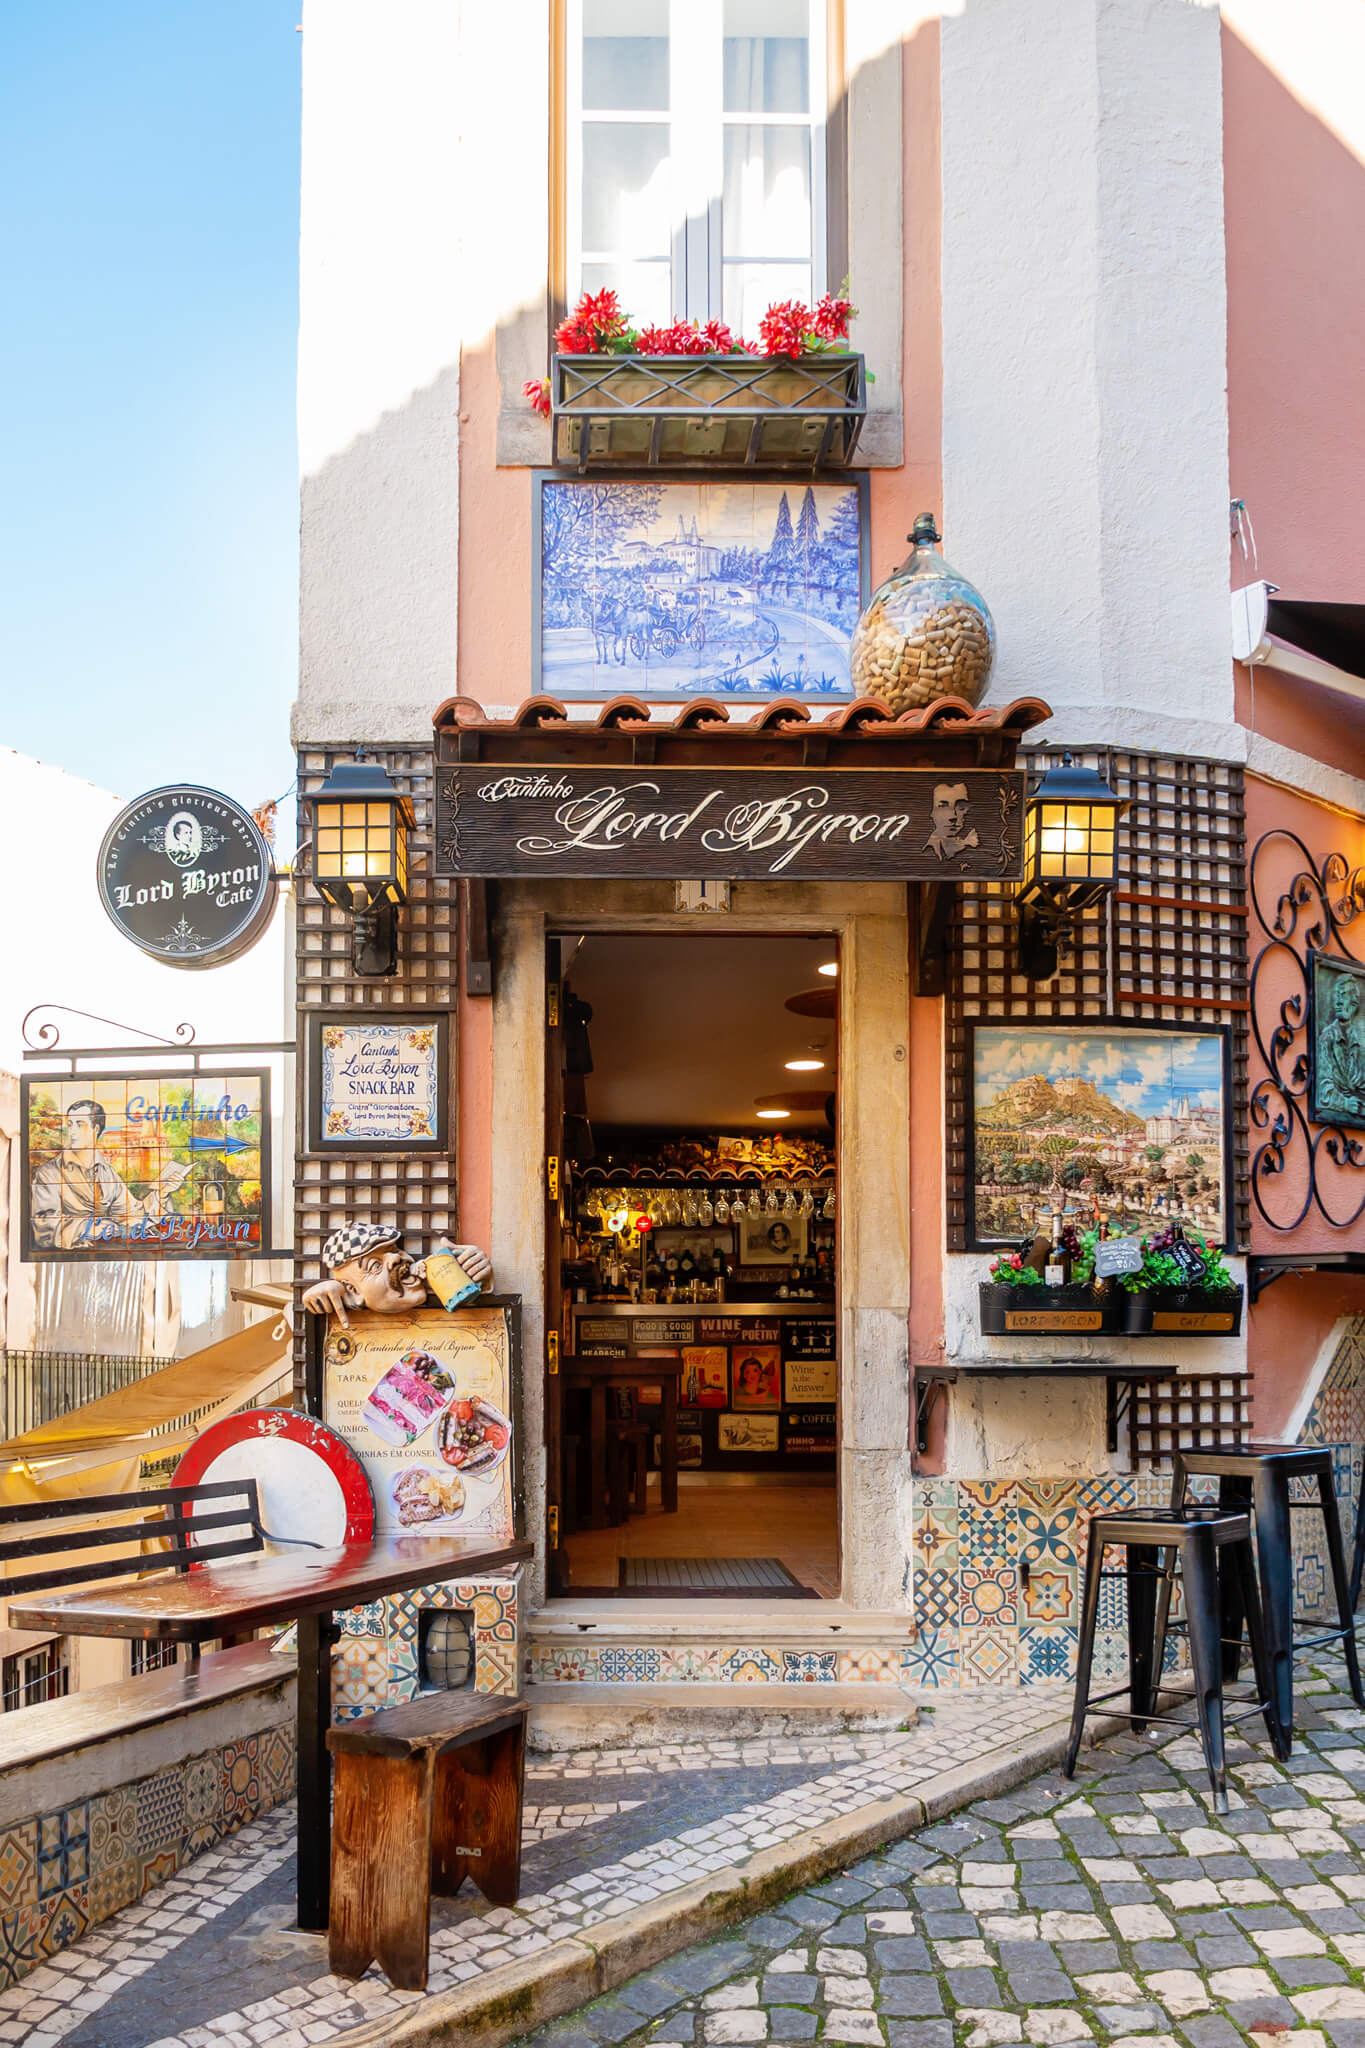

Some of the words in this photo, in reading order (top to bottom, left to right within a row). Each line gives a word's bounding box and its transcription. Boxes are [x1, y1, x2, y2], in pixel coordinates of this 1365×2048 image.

[477, 775, 574, 803] Cantinho
[516, 782, 724, 857] Lord
[702, 786, 911, 873] Byron
[114, 879, 175, 910] Lord
[181, 863, 261, 900] Byron
[360, 1042, 400, 1056] Cantinho
[340, 1054, 374, 1077] Lord
[375, 1059, 421, 1079] Byron
[349, 1081, 388, 1095] SNACK
[390, 1081, 416, 1095] BAR
[125, 1094, 252, 1123] Cantinho
[80, 1215, 150, 1241] Lord
[158, 1212, 250, 1250] Byron
[635, 1322, 657, 1330] FOOD
[669, 1322, 691, 1330] GOOD
[700, 1318, 742, 1330] WINE
[664, 1331, 692, 1340] BETTER
[741, 1329, 779, 1341] POETRY
[364, 1339, 405, 1352] Cantinho
[443, 1340, 476, 1359] Byron
[581, 1349, 626, 1357] HEADACHE
[790, 1365, 816, 1375] Wine
[791, 1384, 825, 1392] Answer
[338, 1425, 368, 1433] VINHOS
